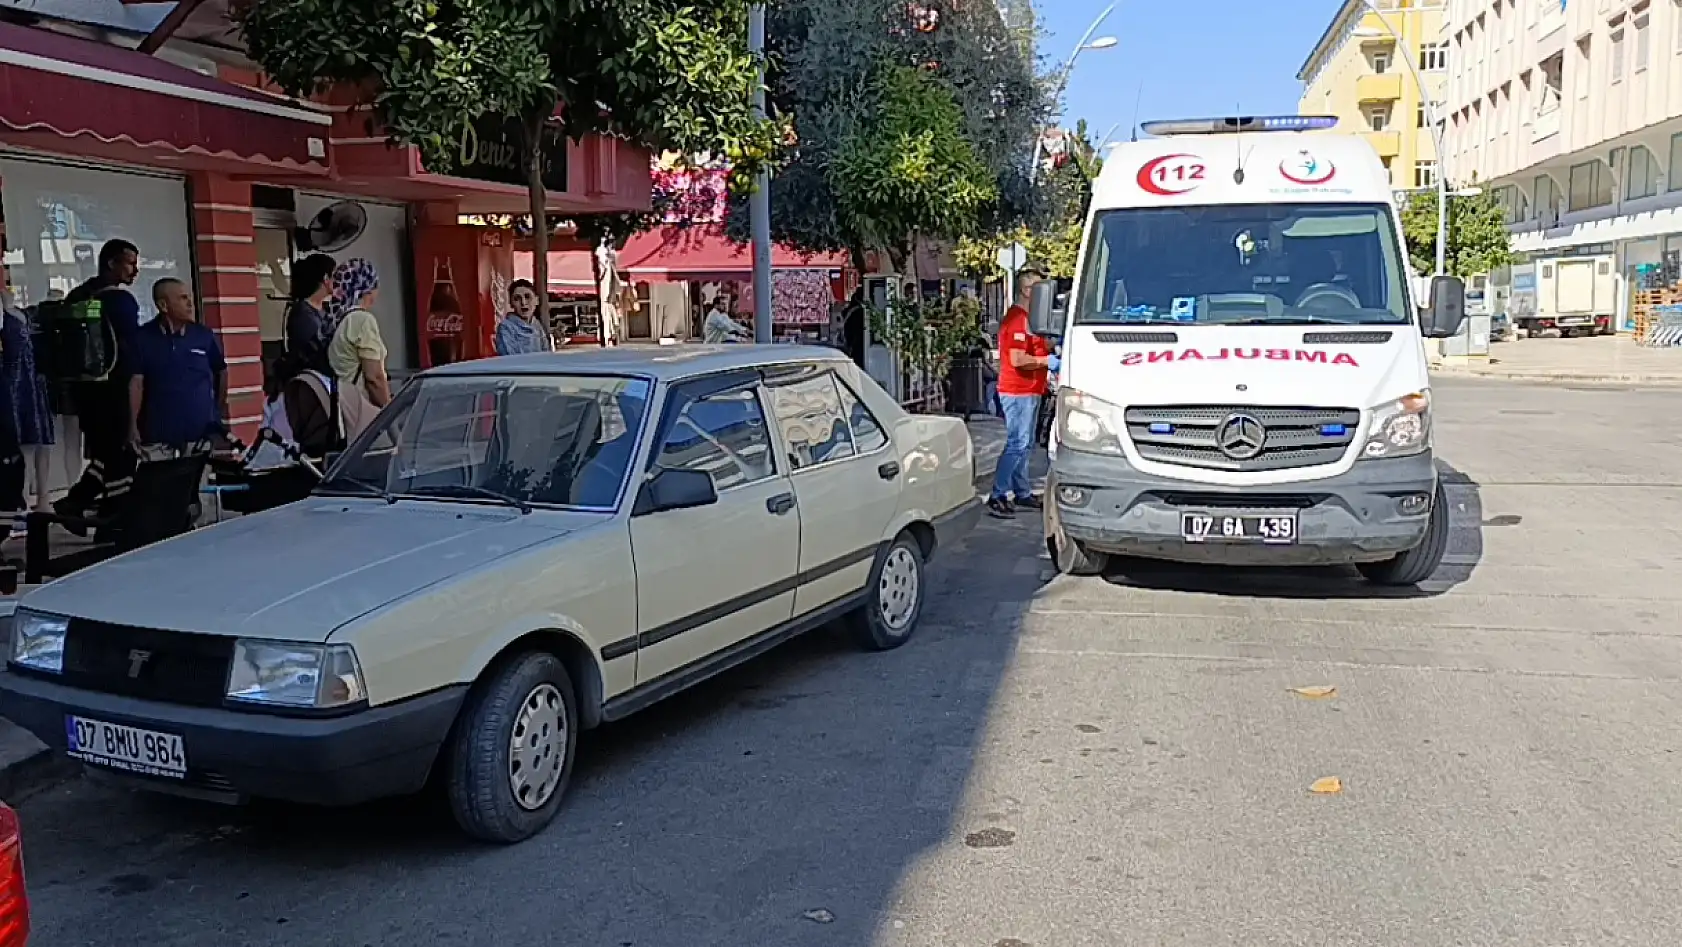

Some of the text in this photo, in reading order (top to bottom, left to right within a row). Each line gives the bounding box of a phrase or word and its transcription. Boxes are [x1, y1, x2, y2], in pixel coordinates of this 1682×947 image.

[460, 112, 516, 170] Deniz
[1155, 164, 1205, 182] 112
[1192, 516, 1213, 537] 07
[1258, 517, 1292, 538] 439
[75, 719, 96, 749] 07
[104, 725, 140, 760] BMU
[144, 733, 184, 767] 964
